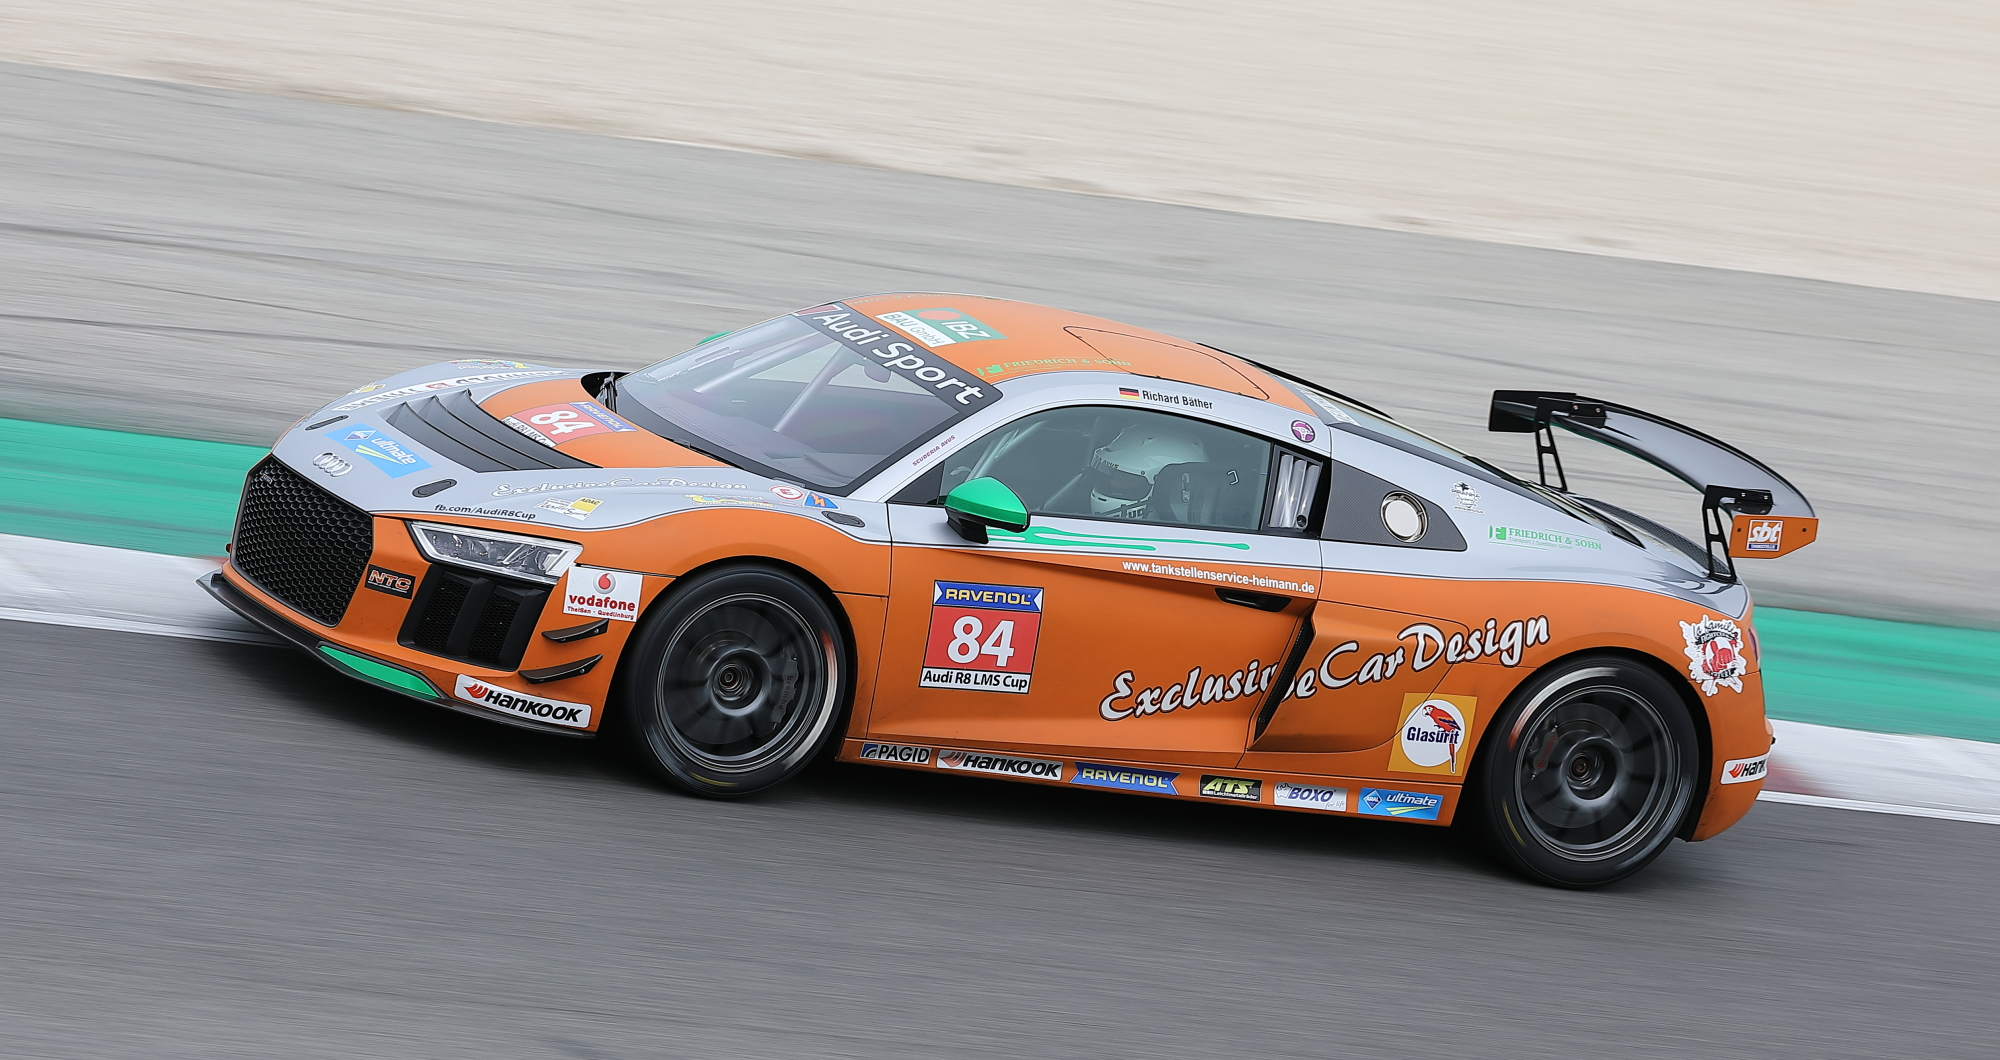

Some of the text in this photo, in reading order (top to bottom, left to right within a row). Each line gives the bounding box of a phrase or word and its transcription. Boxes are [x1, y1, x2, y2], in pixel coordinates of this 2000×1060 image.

[881, 312, 913, 329] BAU
[940, 320, 992, 339] IBZ
[812, 312, 985, 405] Audi Sport
[1142, 390, 1213, 409] Richard Bäther
[530, 410, 597, 435] 84
[370, 437, 417, 465] ultimate
[912, 434, 956, 467] SCUDERIA AVUS
[434, 503, 537, 520] fb.com/AudiR8Cup
[1508, 527, 1603, 550] FRIEDRICH & SOHN
[1748, 522, 1781, 543] sbt
[368, 569, 412, 590] NTC
[1121, 560, 1316, 594] www.tankstellenservice-heimann.de
[568, 594, 636, 611] vodafone
[945, 588, 1031, 605] RAVENOL
[947, 615, 1015, 667] 84
[923, 670, 1028, 691] Audi R8 LMS Cup
[1406, 726, 1460, 745] Glasurit
[877, 745, 930, 763] PAGID
[1082, 768, 1168, 788] RAVENOL
[1202, 778, 1255, 794] ATS
[1288, 787, 1334, 802] BOXO
[1386, 793, 1438, 807] ultimate
